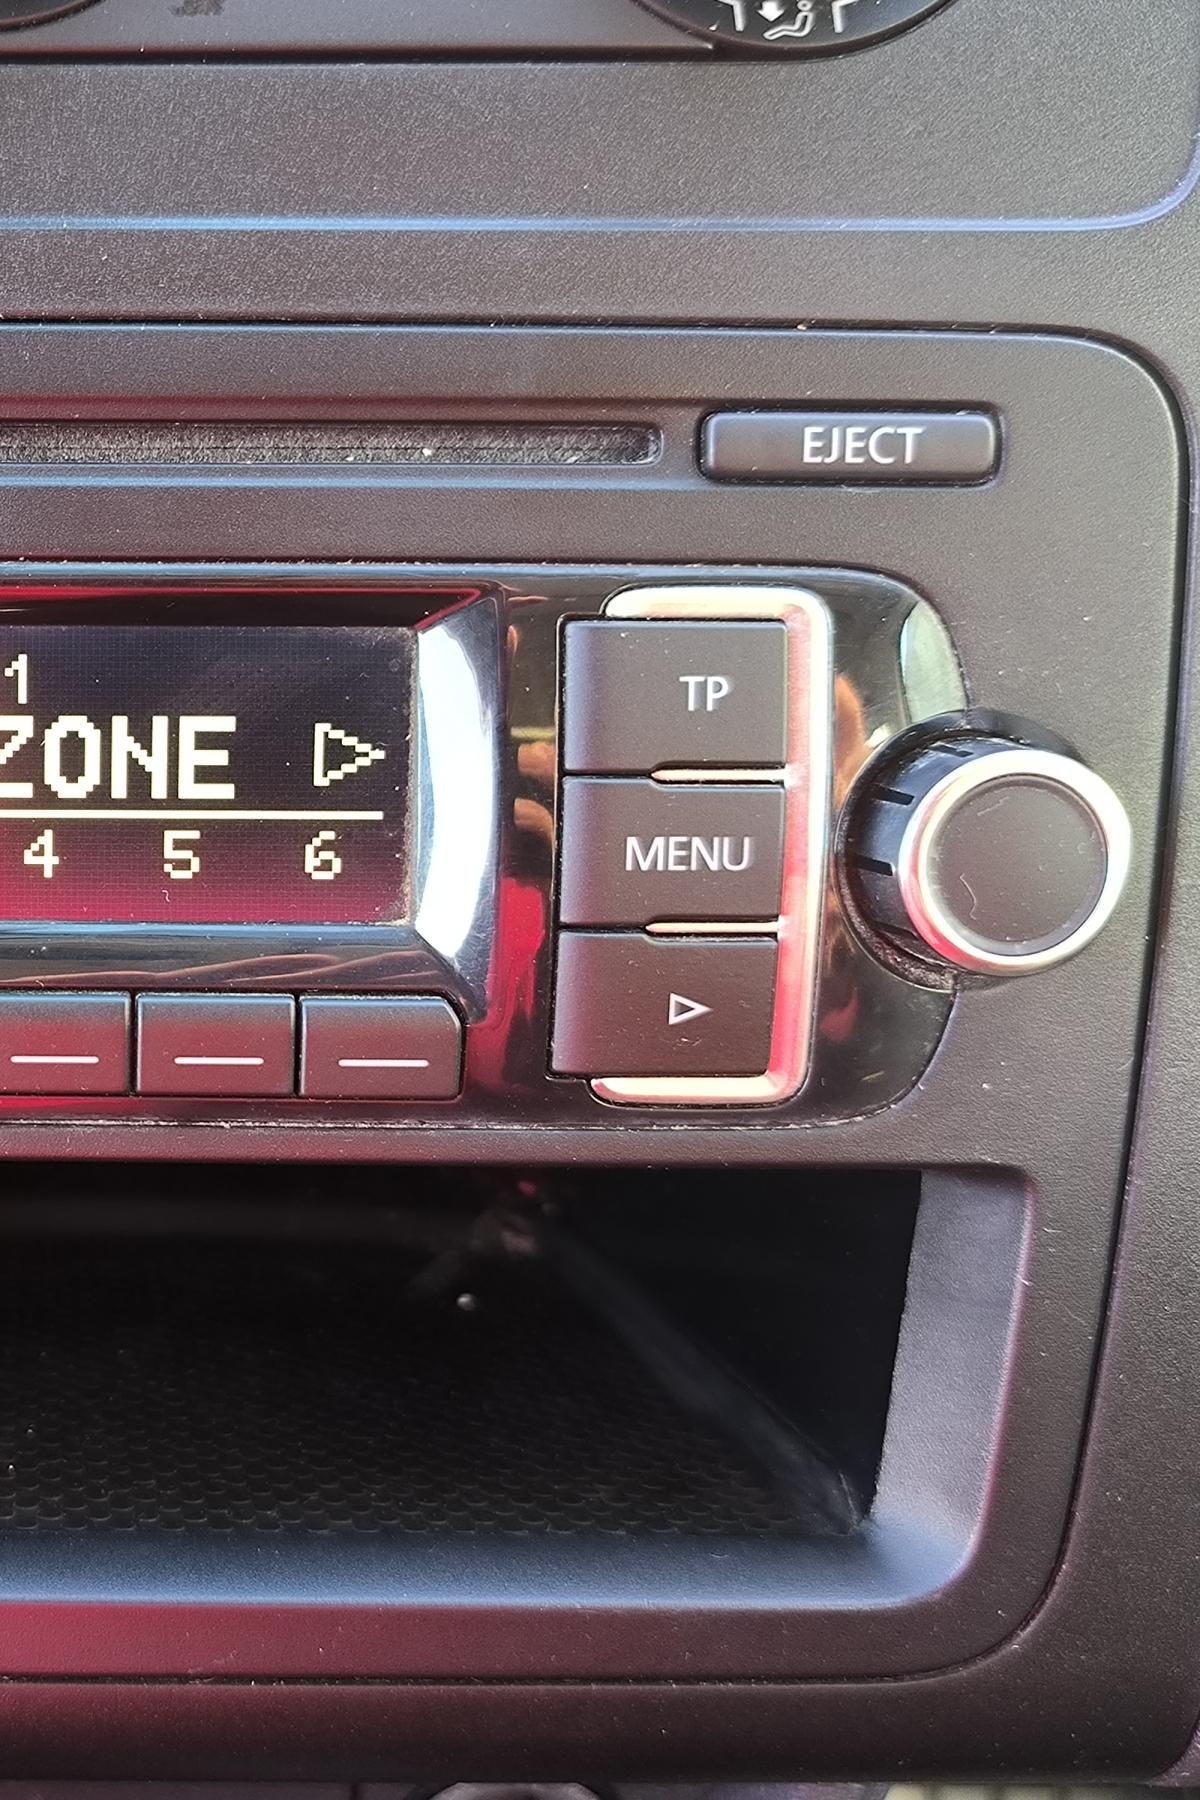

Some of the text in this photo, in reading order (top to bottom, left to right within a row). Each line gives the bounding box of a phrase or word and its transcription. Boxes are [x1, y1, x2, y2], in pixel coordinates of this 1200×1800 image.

[802, 425, 926, 465] EJECT
[678, 675, 731, 712] TP
[23, 829, 60, 879] 4
[163, 829, 201, 880] 5
[304, 830, 342, 881] 6
[625, 836, 751, 872] MENU
